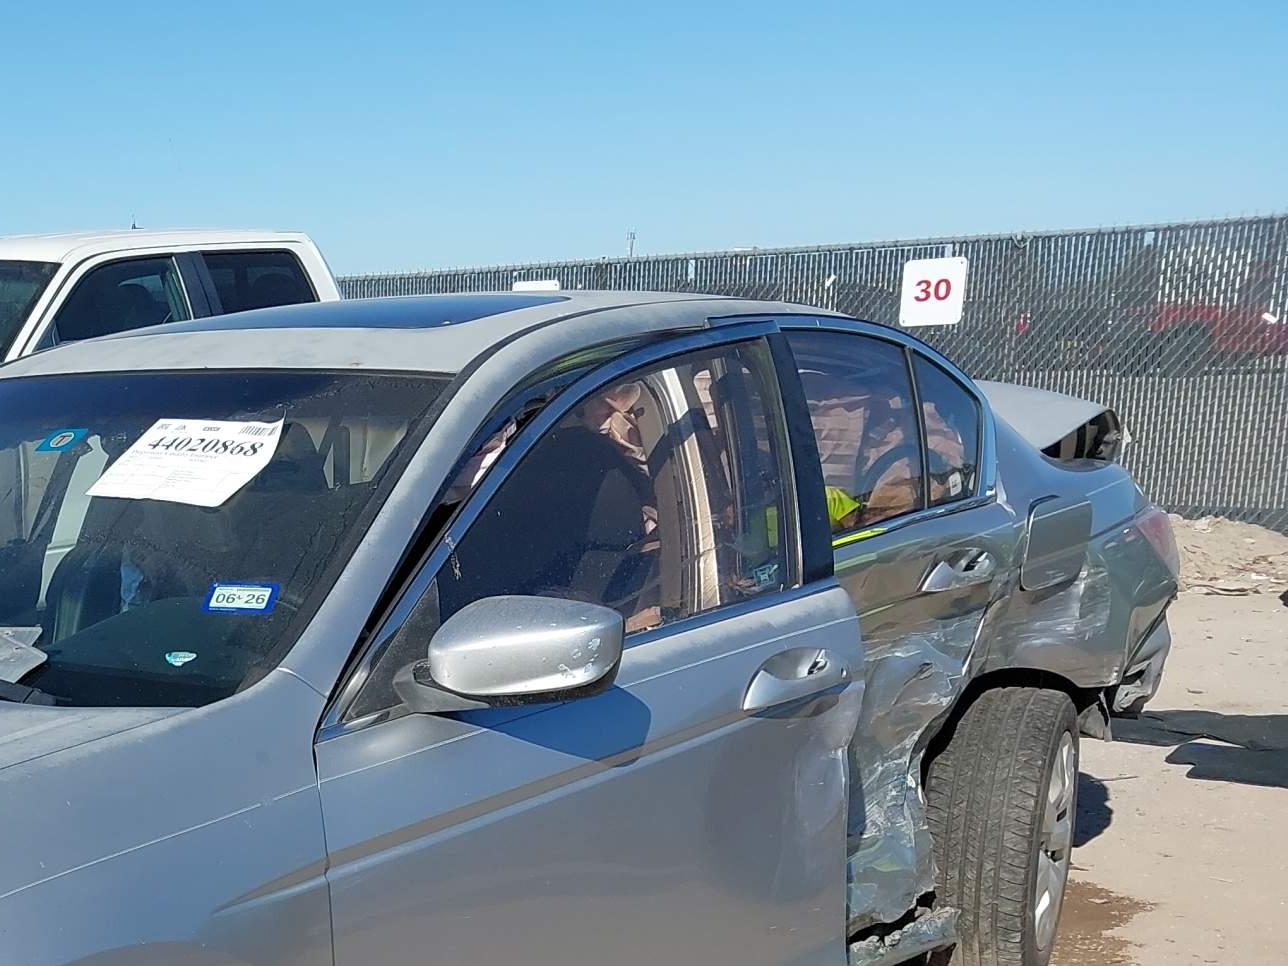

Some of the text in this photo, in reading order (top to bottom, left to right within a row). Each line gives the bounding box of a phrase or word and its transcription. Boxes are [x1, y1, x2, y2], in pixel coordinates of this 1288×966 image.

[913, 278, 952, 302] 30
[147, 436, 264, 457] 44020868
[215, 593, 267, 604] 06 26
